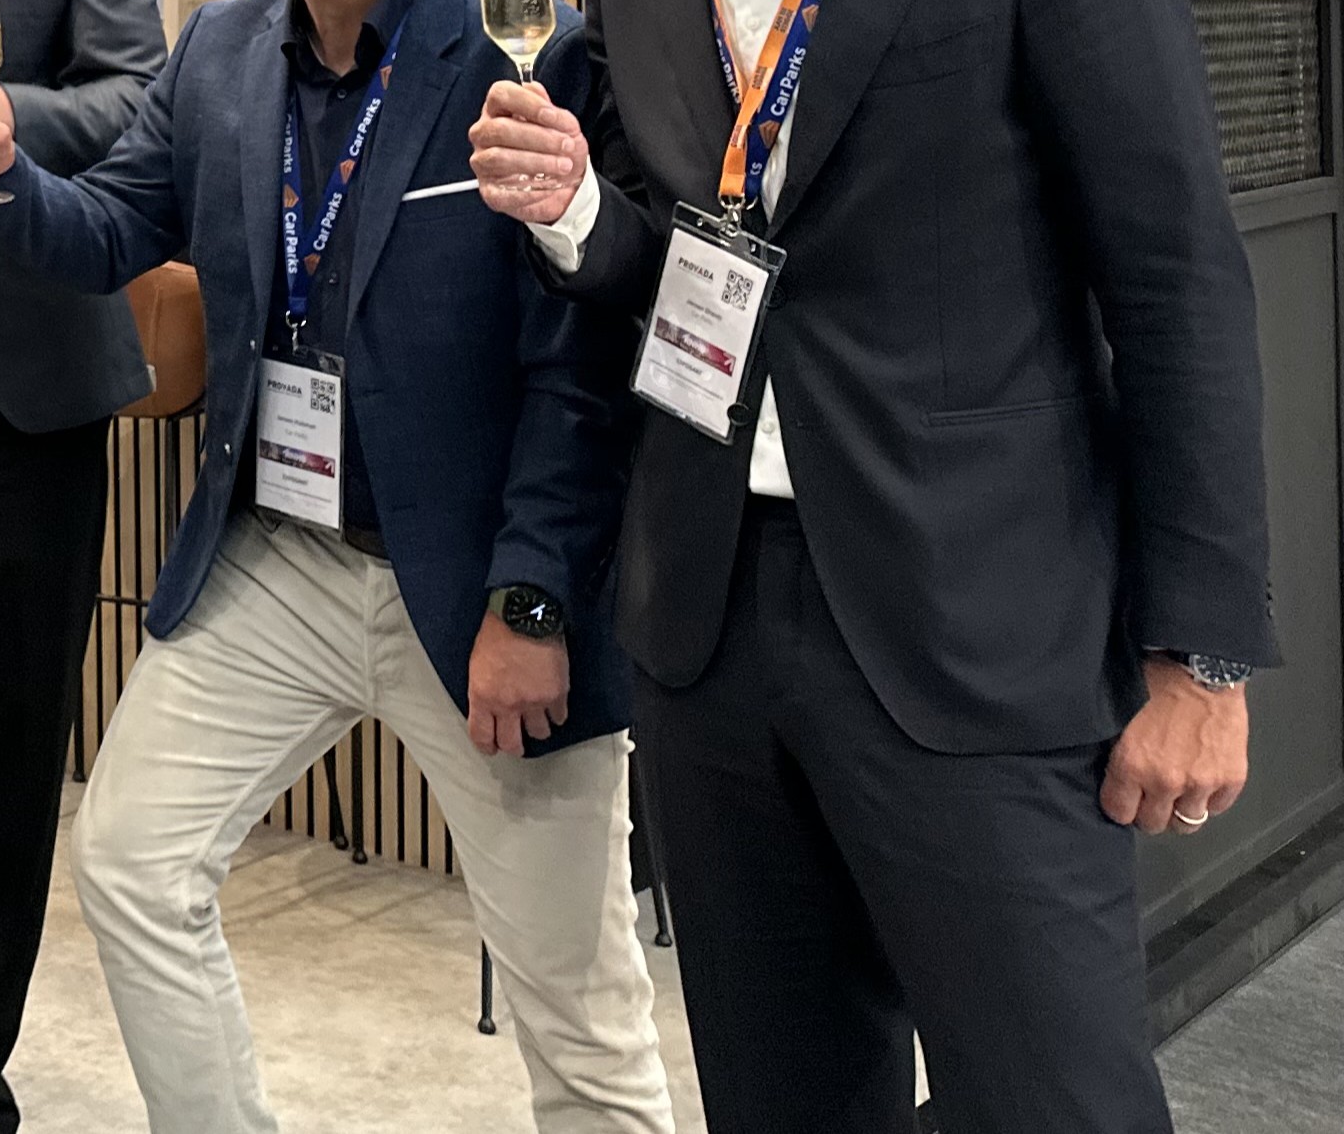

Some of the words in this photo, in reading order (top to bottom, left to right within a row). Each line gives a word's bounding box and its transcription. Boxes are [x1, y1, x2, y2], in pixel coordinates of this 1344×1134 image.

[770, 91, 790, 116] Car
[780, 46, 806, 91] Parks
[349, 133, 364, 157] Car
[358, 98, 381, 133] Parks
[284, 212, 297, 236] Car
[321, 192, 343, 228] Parks
[286, 236, 299, 274] Parks
[313, 228, 330, 251] Car
